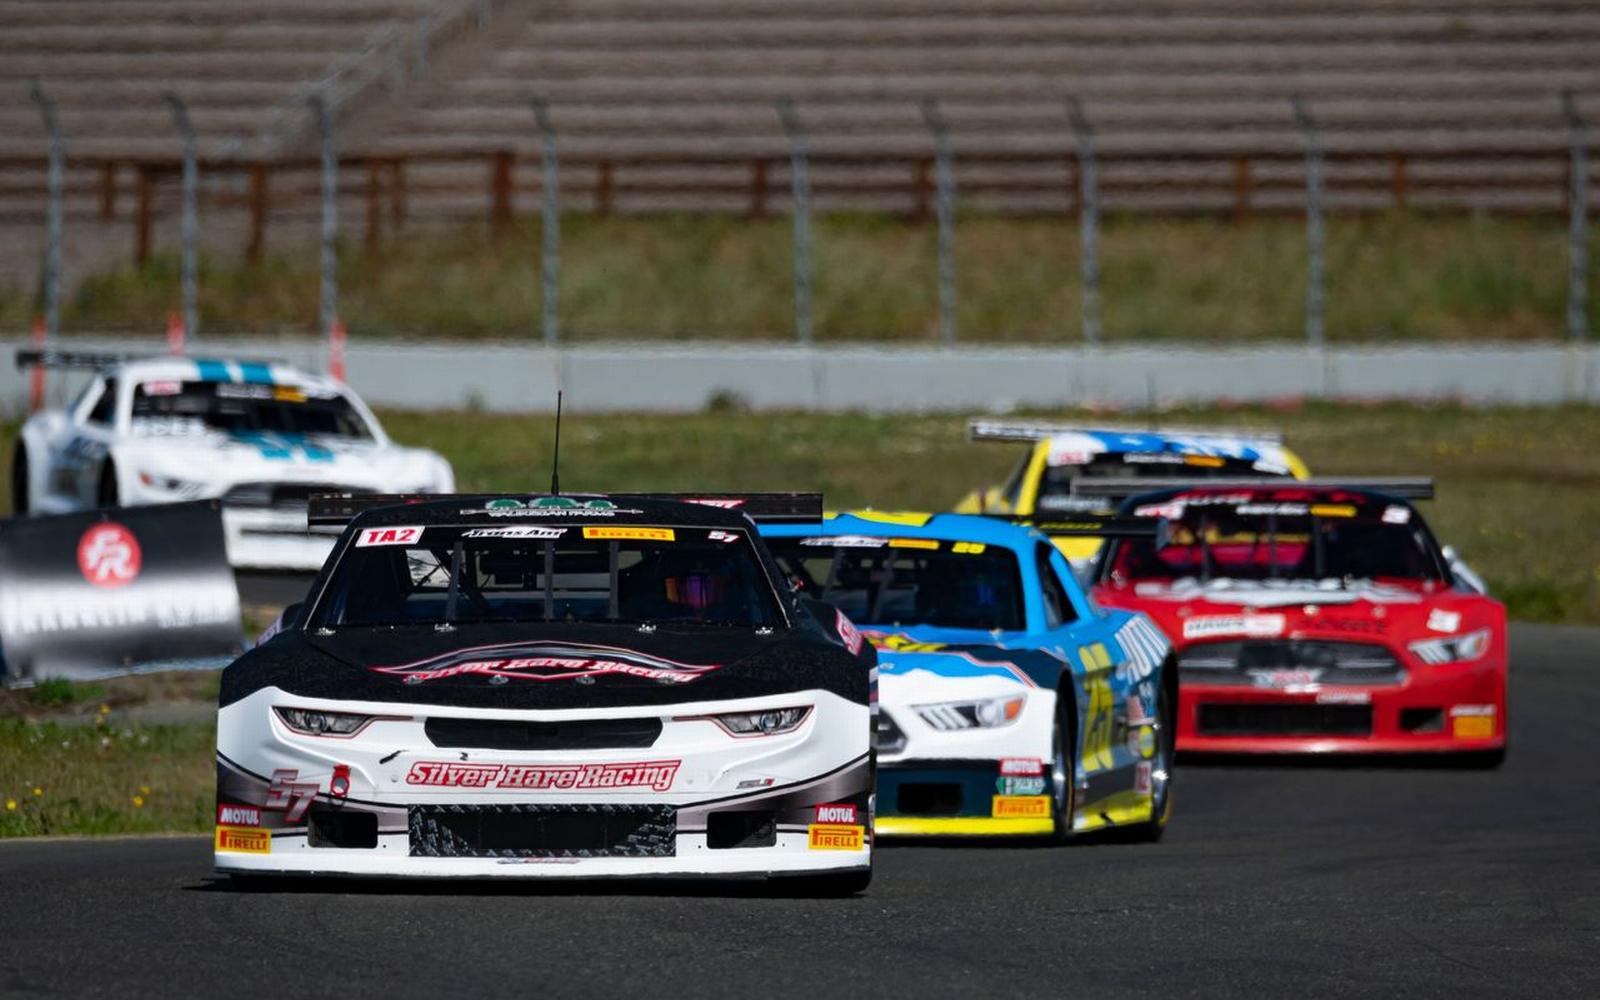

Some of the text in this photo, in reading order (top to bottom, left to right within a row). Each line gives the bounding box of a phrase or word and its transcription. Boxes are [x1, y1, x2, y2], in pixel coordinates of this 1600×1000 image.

[367, 529, 416, 544] TA2
[461, 527, 520, 538] Trans
[708, 530, 740, 543] 57
[407, 760, 681, 791] Silver Hare Racing
[265, 768, 320, 822] 57
[220, 807, 260, 825] MOTUL
[817, 807, 855, 823] MOTUL
[219, 830, 268, 851] PIRELLI
[812, 828, 860, 848] PIRELLI
